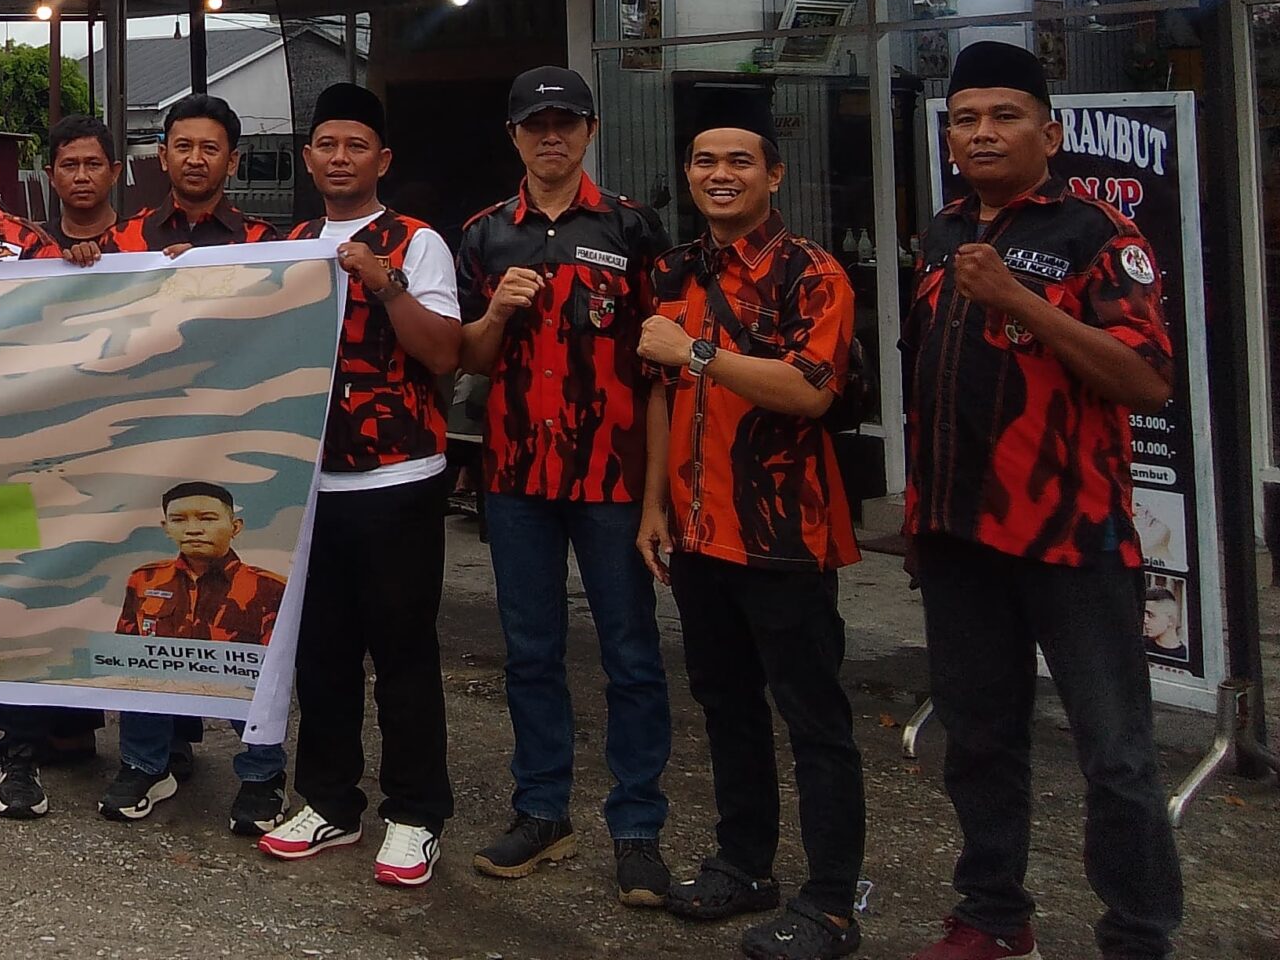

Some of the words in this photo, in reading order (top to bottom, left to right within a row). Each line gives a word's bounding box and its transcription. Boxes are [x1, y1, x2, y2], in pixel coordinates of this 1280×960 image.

[1061, 109, 1167, 175] RAMBUT
[1128, 414, 1175, 433] 35.000,-
[1130, 440, 1177, 459] 10.000,-
[1131, 467, 1169, 482] ambut
[1143, 556, 1166, 568] ajah
[144, 645, 217, 660] TAUFIK
[94, 654, 124, 667] Sek.
[128, 658, 159, 670] PAC
[162, 660, 184, 671] PP
[189, 662, 220, 674] Kec.
[223, 665, 261, 681] Marp
